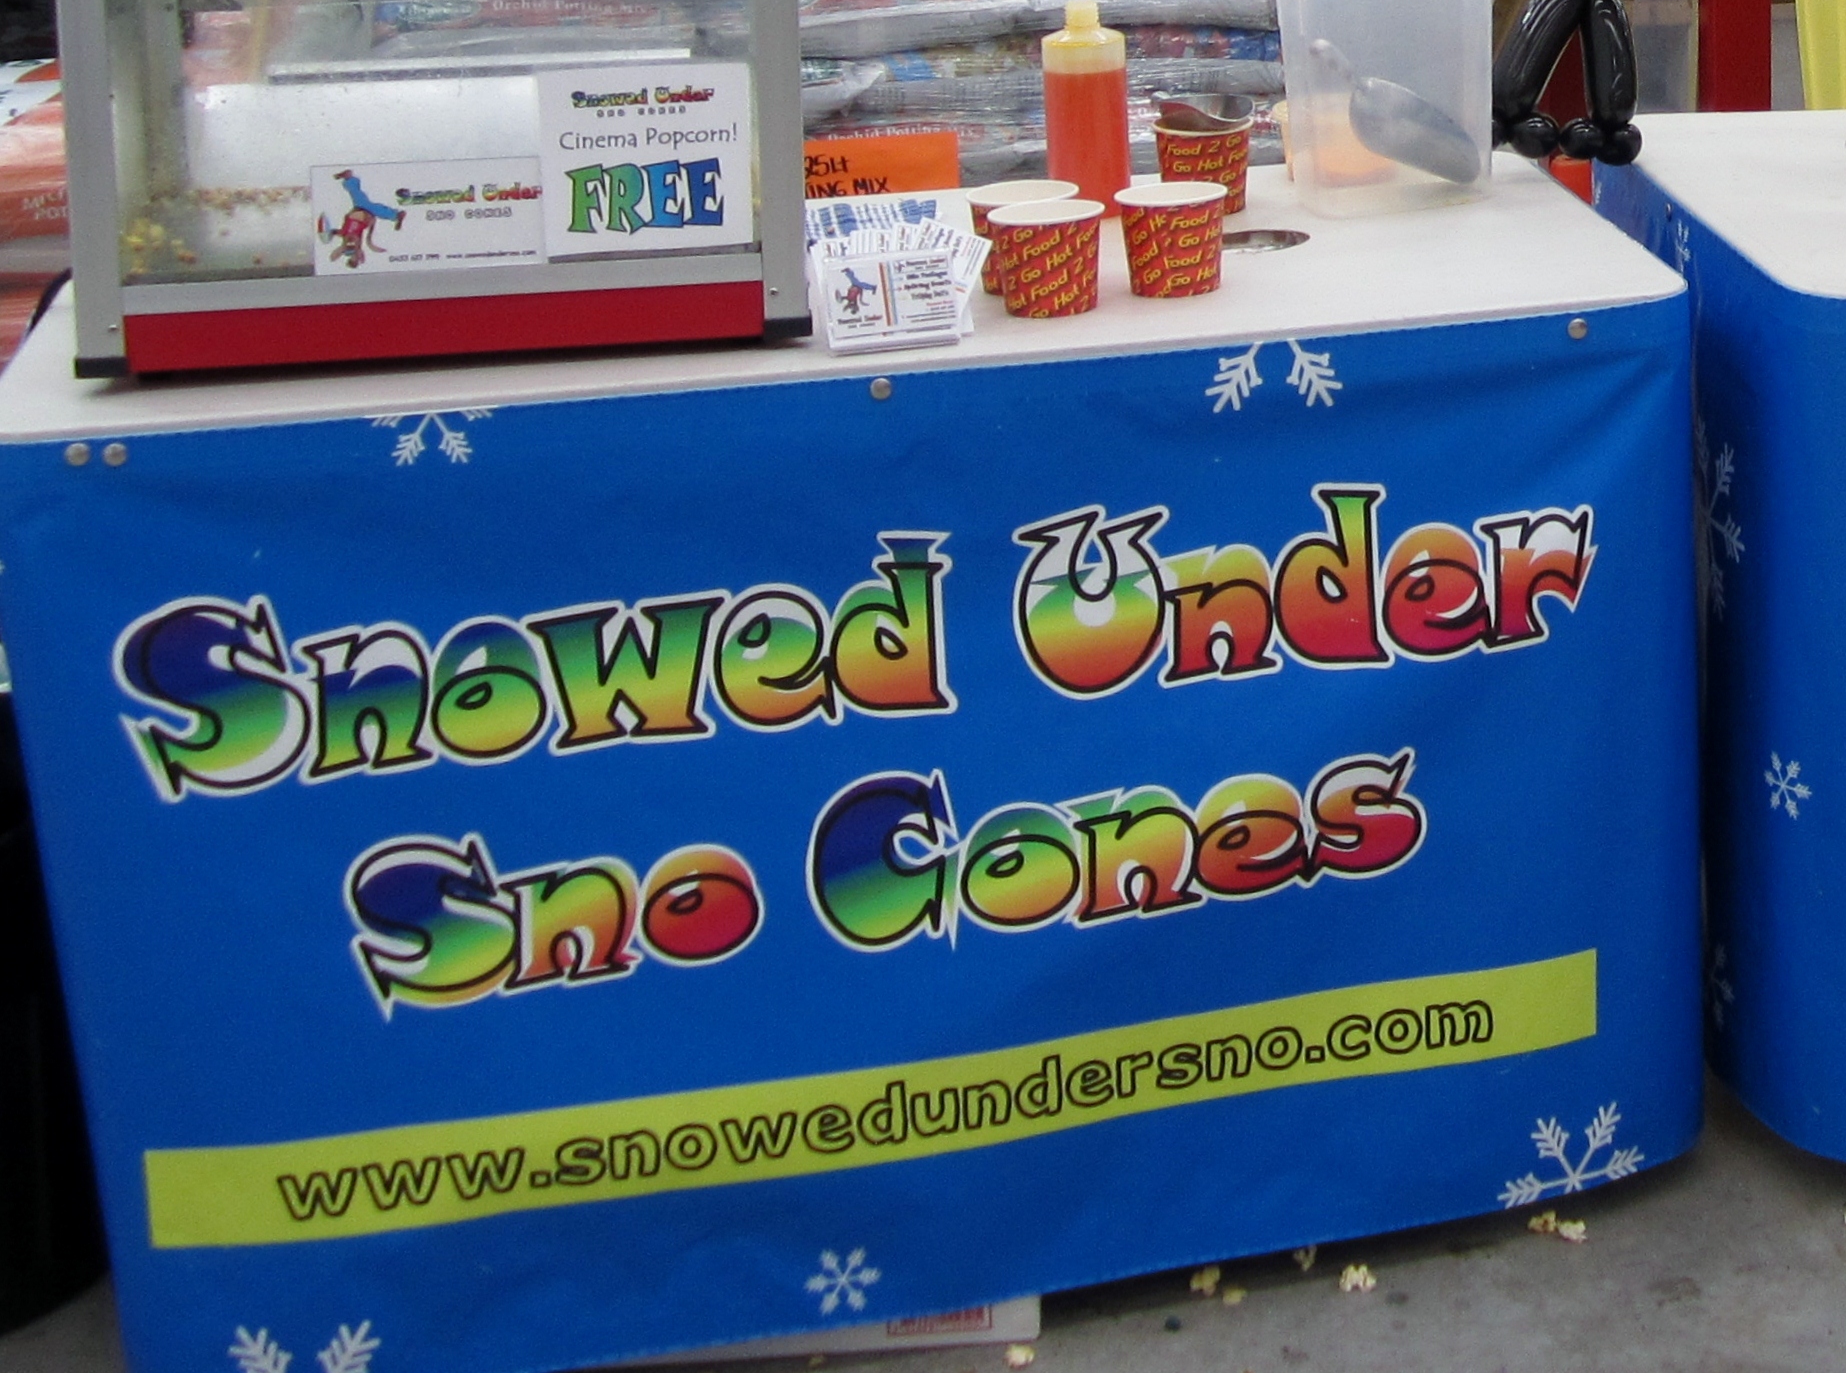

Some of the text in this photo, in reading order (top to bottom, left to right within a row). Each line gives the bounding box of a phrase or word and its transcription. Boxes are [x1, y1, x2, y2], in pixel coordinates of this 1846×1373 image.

[655, 85, 716, 104] Under
[560, 122, 738, 150] Cinema Popcorn!
[1166, 134, 1242, 157] Food 2 Go
[1173, 156, 1224, 174] Go Hot
[852, 176, 892, 195] MIX
[1218, 169, 1237, 184] Go
[564, 156, 726, 235] FREE
[1170, 210, 1210, 231] Food
[1013, 228, 1034, 244] Go
[1023, 229, 1062, 262] Food
[1132, 229, 1149, 246] Go
[1178, 232, 1200, 249] Go
[1046, 244, 1074, 271] Hot
[1021, 268, 1042, 284] Go
[1031, 268, 1069, 302] Food
[1143, 268, 1162, 285] Go
[1054, 283, 1081, 311] Hot
[114, 484, 1598, 803] Snowed Under
[344, 746, 1426, 1025] Sno Cones
[278, 992, 1496, 1227] www.snowedundersno.com
